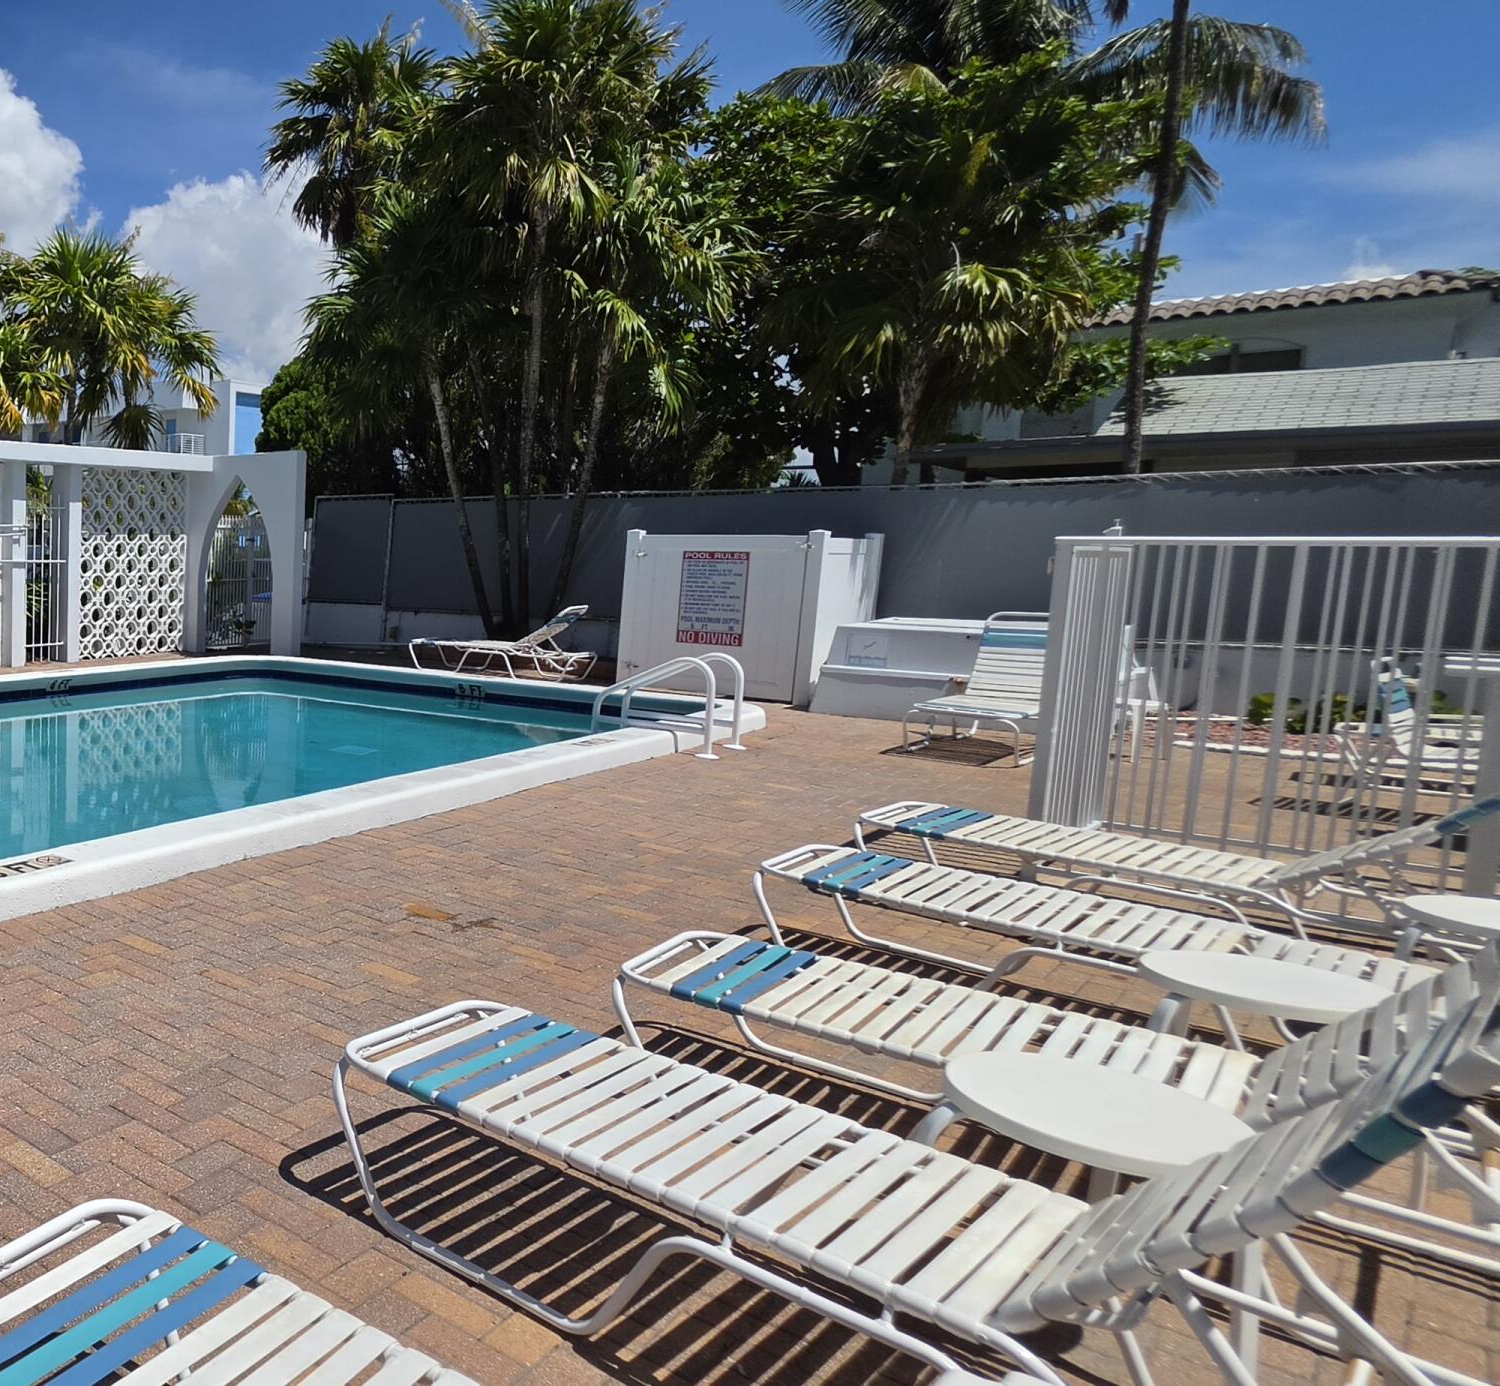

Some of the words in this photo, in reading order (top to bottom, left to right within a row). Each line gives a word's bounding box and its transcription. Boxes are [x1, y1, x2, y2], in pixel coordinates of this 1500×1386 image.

[678, 631, 695, 642] NO
[698, 632, 739, 646] DIVING
[58, 679, 73, 689] FT
[469, 684, 482, 696] FT
[3, 861, 42, 874] FT
